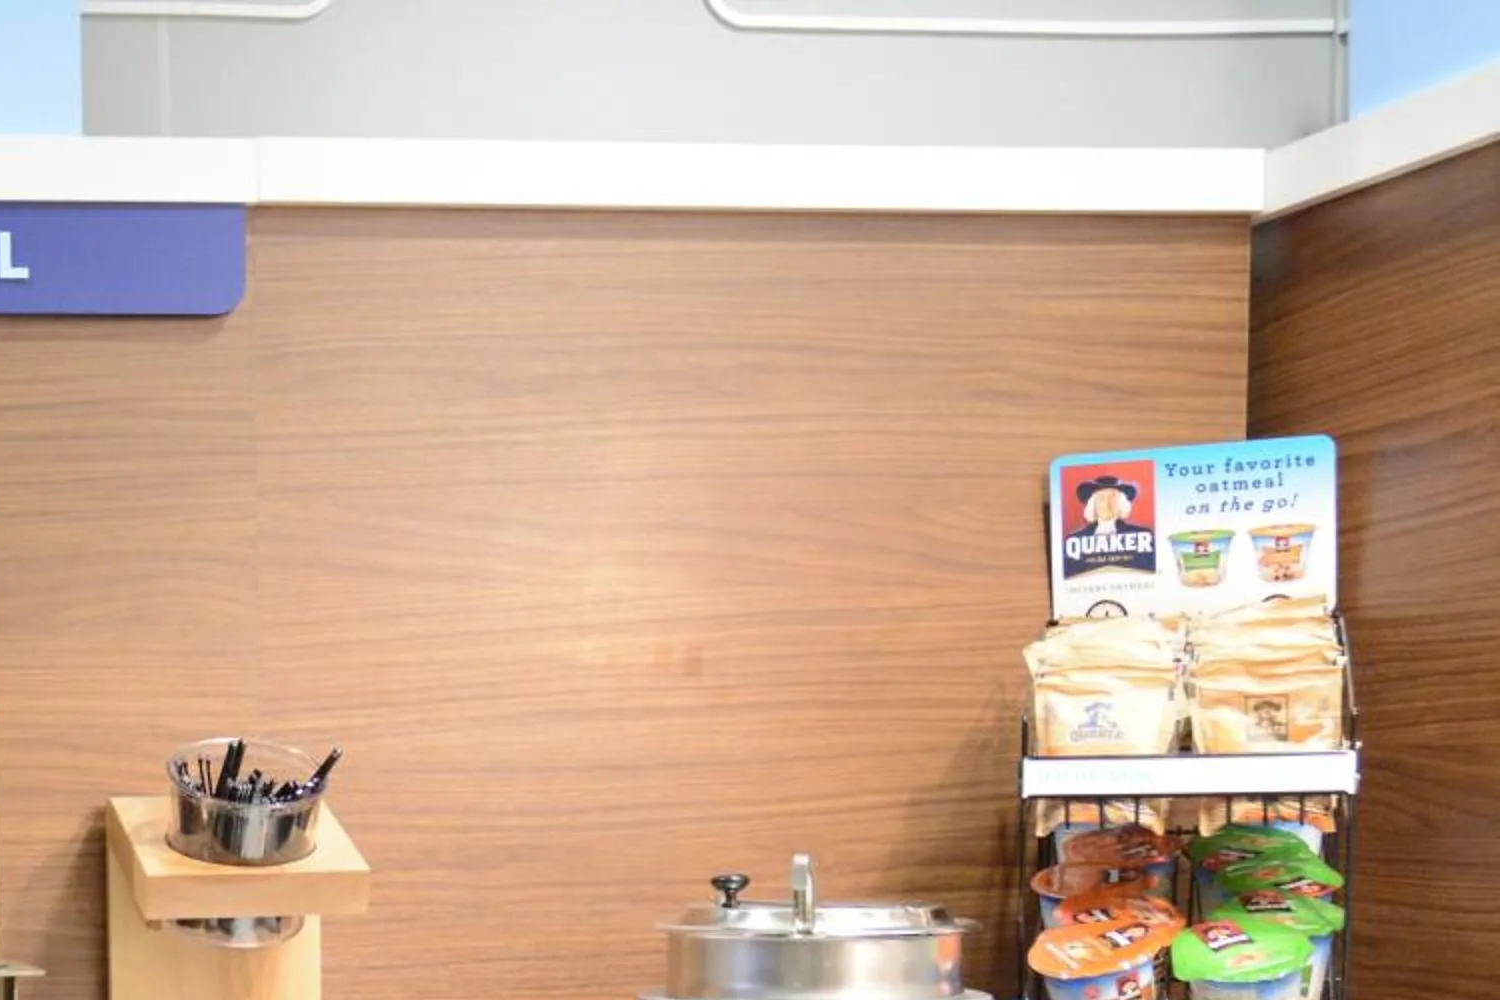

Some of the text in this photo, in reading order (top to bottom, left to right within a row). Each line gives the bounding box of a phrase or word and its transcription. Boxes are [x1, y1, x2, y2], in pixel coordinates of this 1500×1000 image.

[1164, 455, 1315, 477] Your favorite
[1195, 471, 1284, 493] oatmeal
[1185, 493, 1299, 515] on the go!
[1066, 531, 1154, 560] QUAKER
